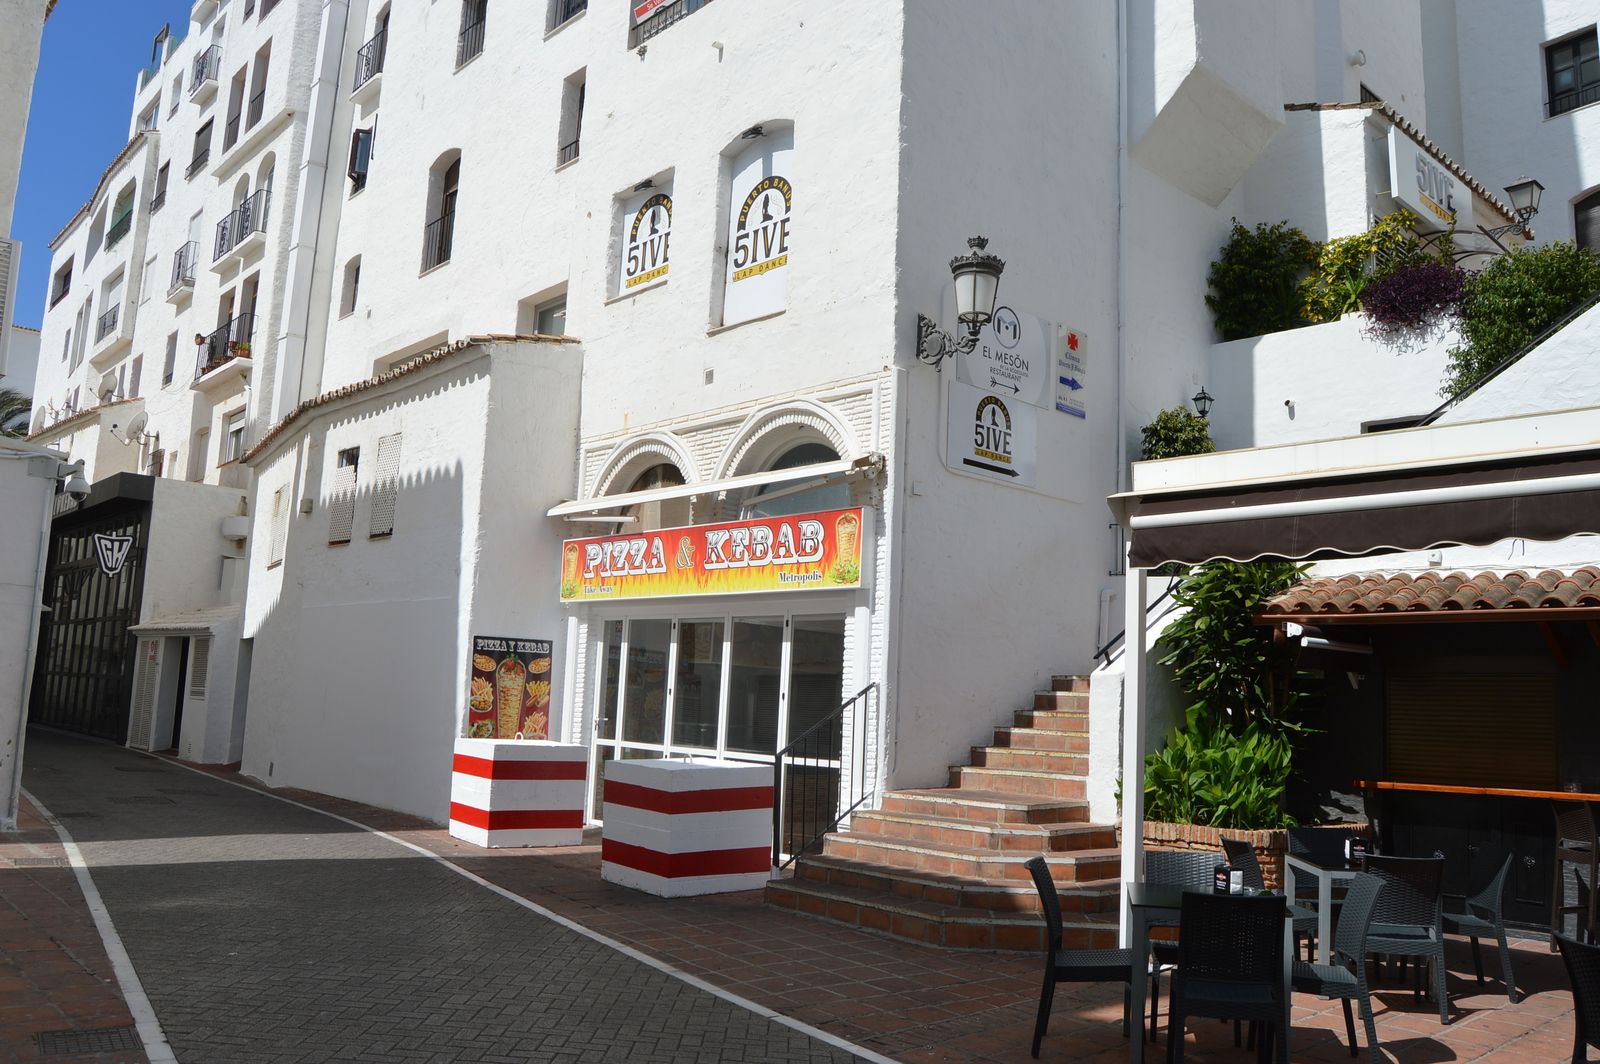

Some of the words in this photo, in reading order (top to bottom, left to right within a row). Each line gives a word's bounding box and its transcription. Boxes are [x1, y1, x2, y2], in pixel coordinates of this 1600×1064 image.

[659, 196, 672, 221] BANU
[739, 180, 770, 222] PUERTO
[773, 178, 792, 207] BANUS
[626, 231, 671, 277] 5IVE
[733, 216, 791, 269] 5IVE
[646, 266, 666, 280] DANC
[736, 268, 753, 280] LAP
[758, 255, 788, 272] DANCE
[982, 345, 992, 359] EL
[990, 366, 1021, 382] RESTAURANT
[974, 423, 1012, 455] 5IVE
[584, 536, 667, 579] PIZZA
[675, 536, 695, 569] &
[704, 519, 825, 571] KEBAB
[584, 585, 597, 594] Take
[779, 570, 822, 584] Metropolis
[476, 638, 507, 651] PIZZA
[508, 641, 516, 651] Y
[516, 641, 550, 653] KEBAB
